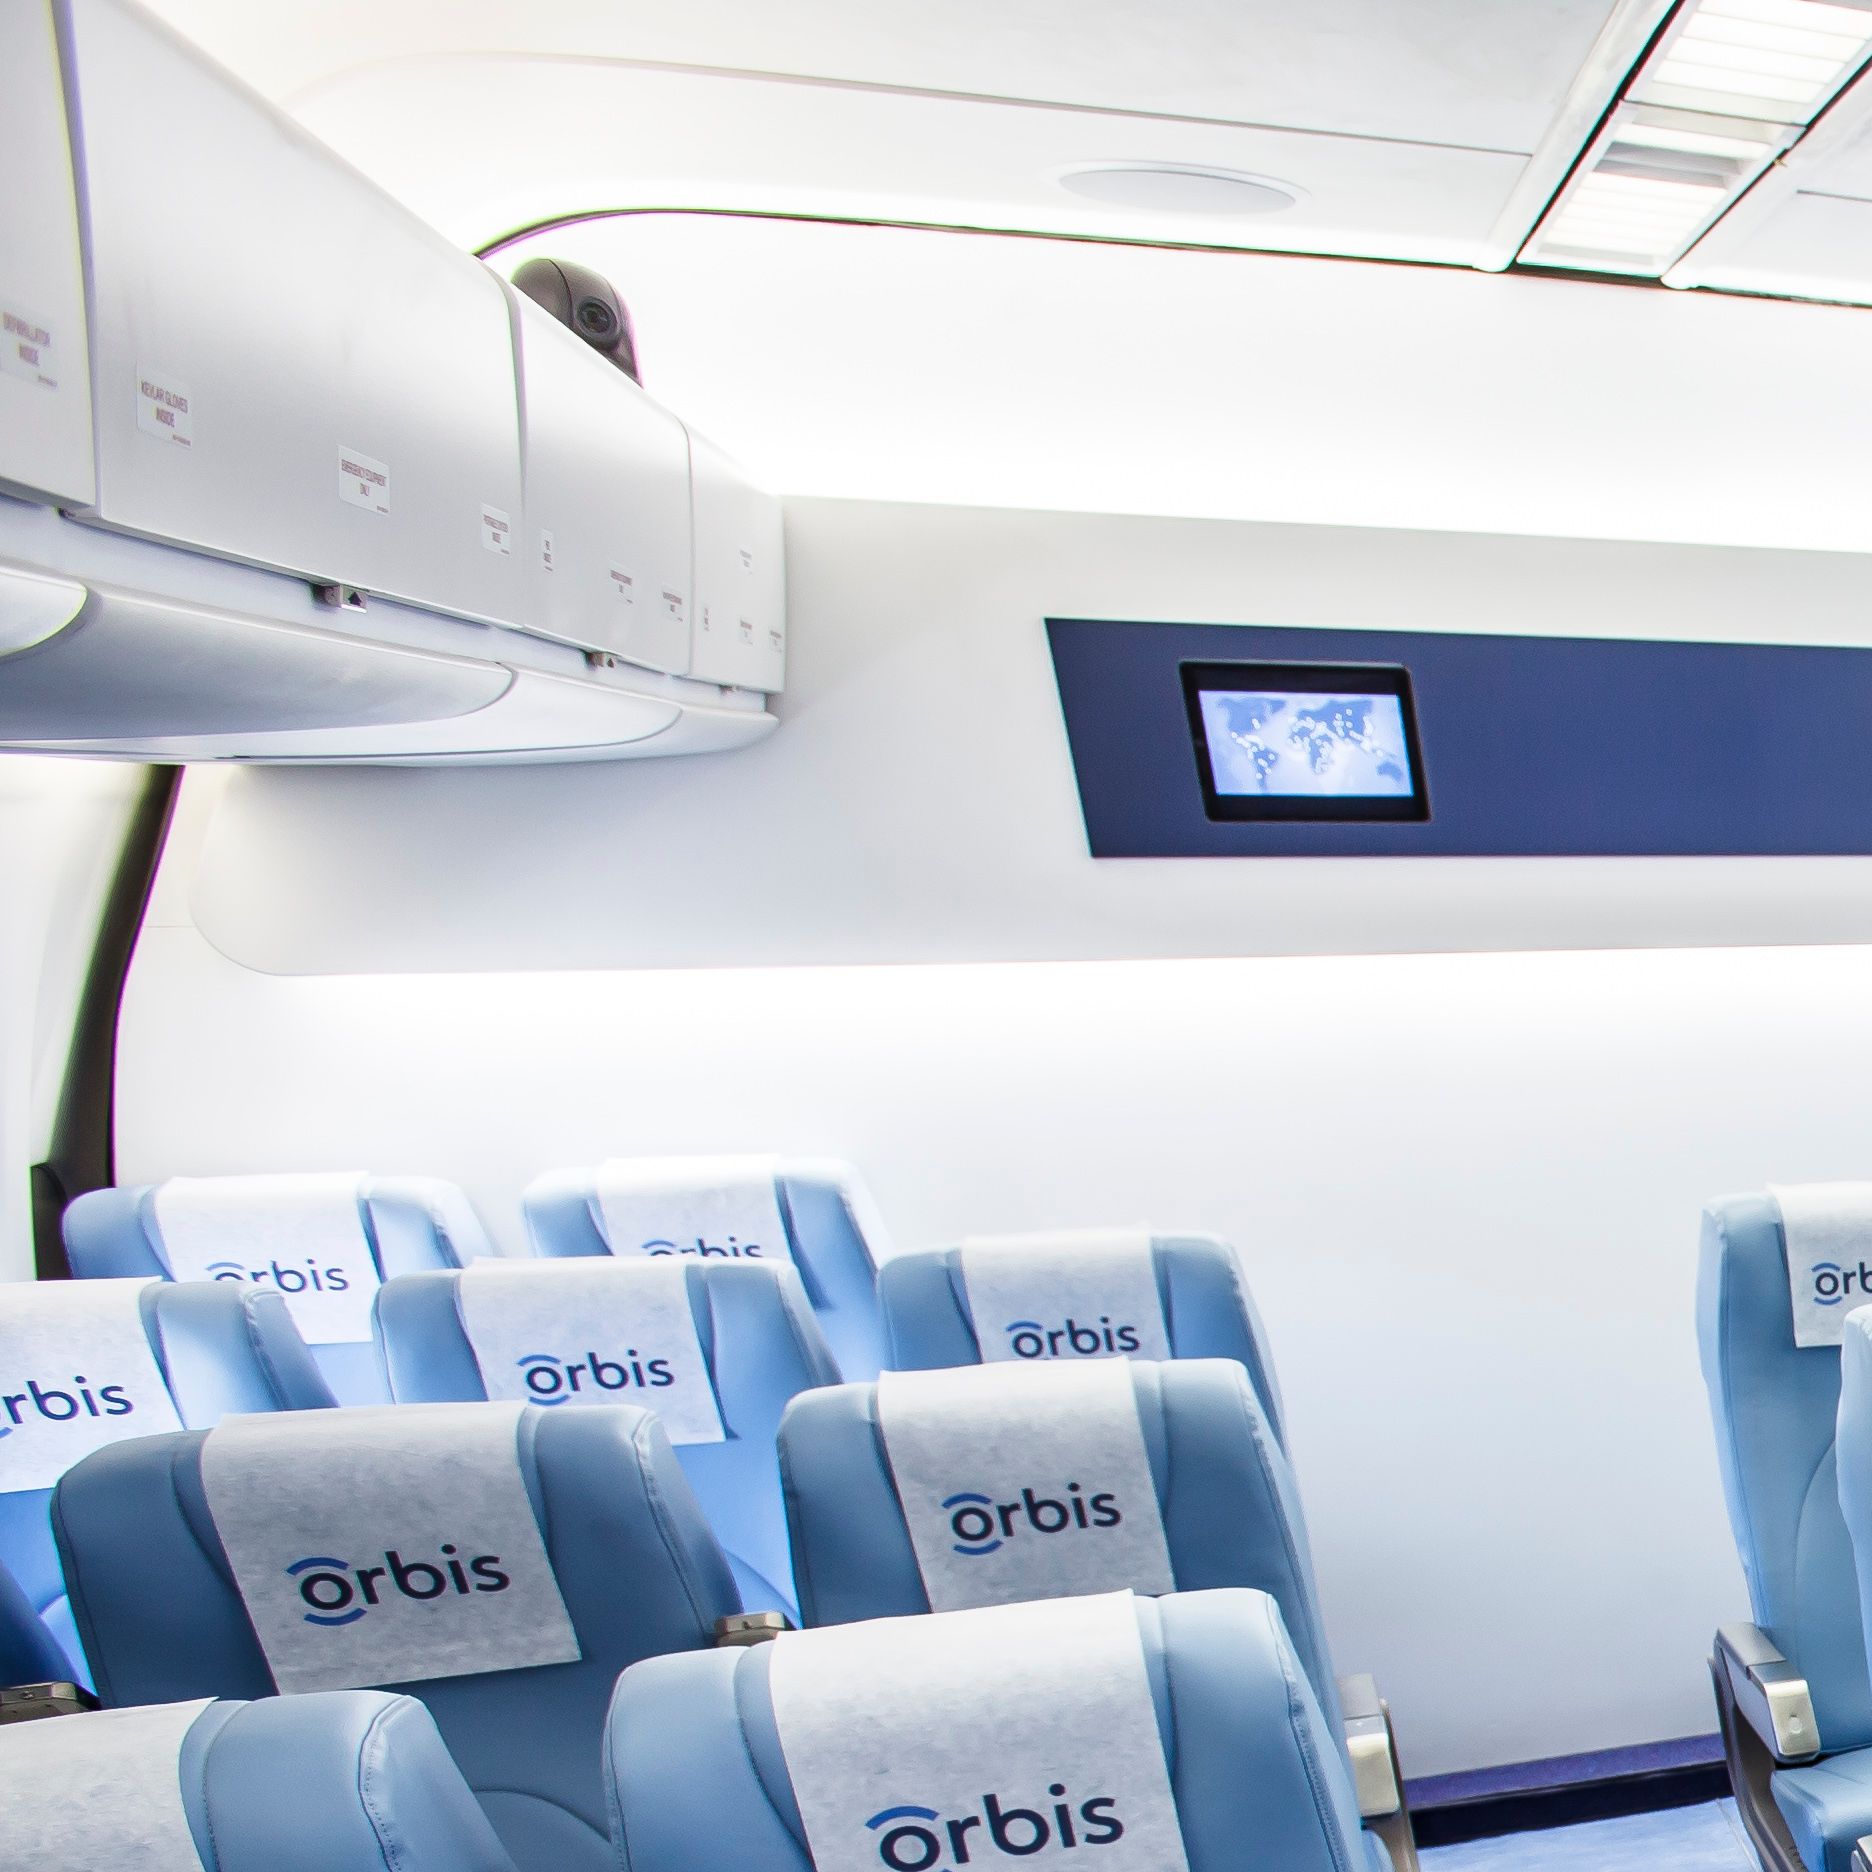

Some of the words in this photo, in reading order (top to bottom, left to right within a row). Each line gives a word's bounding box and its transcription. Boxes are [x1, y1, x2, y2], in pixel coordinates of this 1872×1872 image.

[1013, 1317, 1139, 1358] orbis
[527, 1350, 674, 1394] orbis
[3, 1376, 133, 1424] rbis
[952, 1483, 1120, 1541] orbis
[301, 1544, 509, 1610] orbis
[881, 1784, 1123, 1872] orbis
